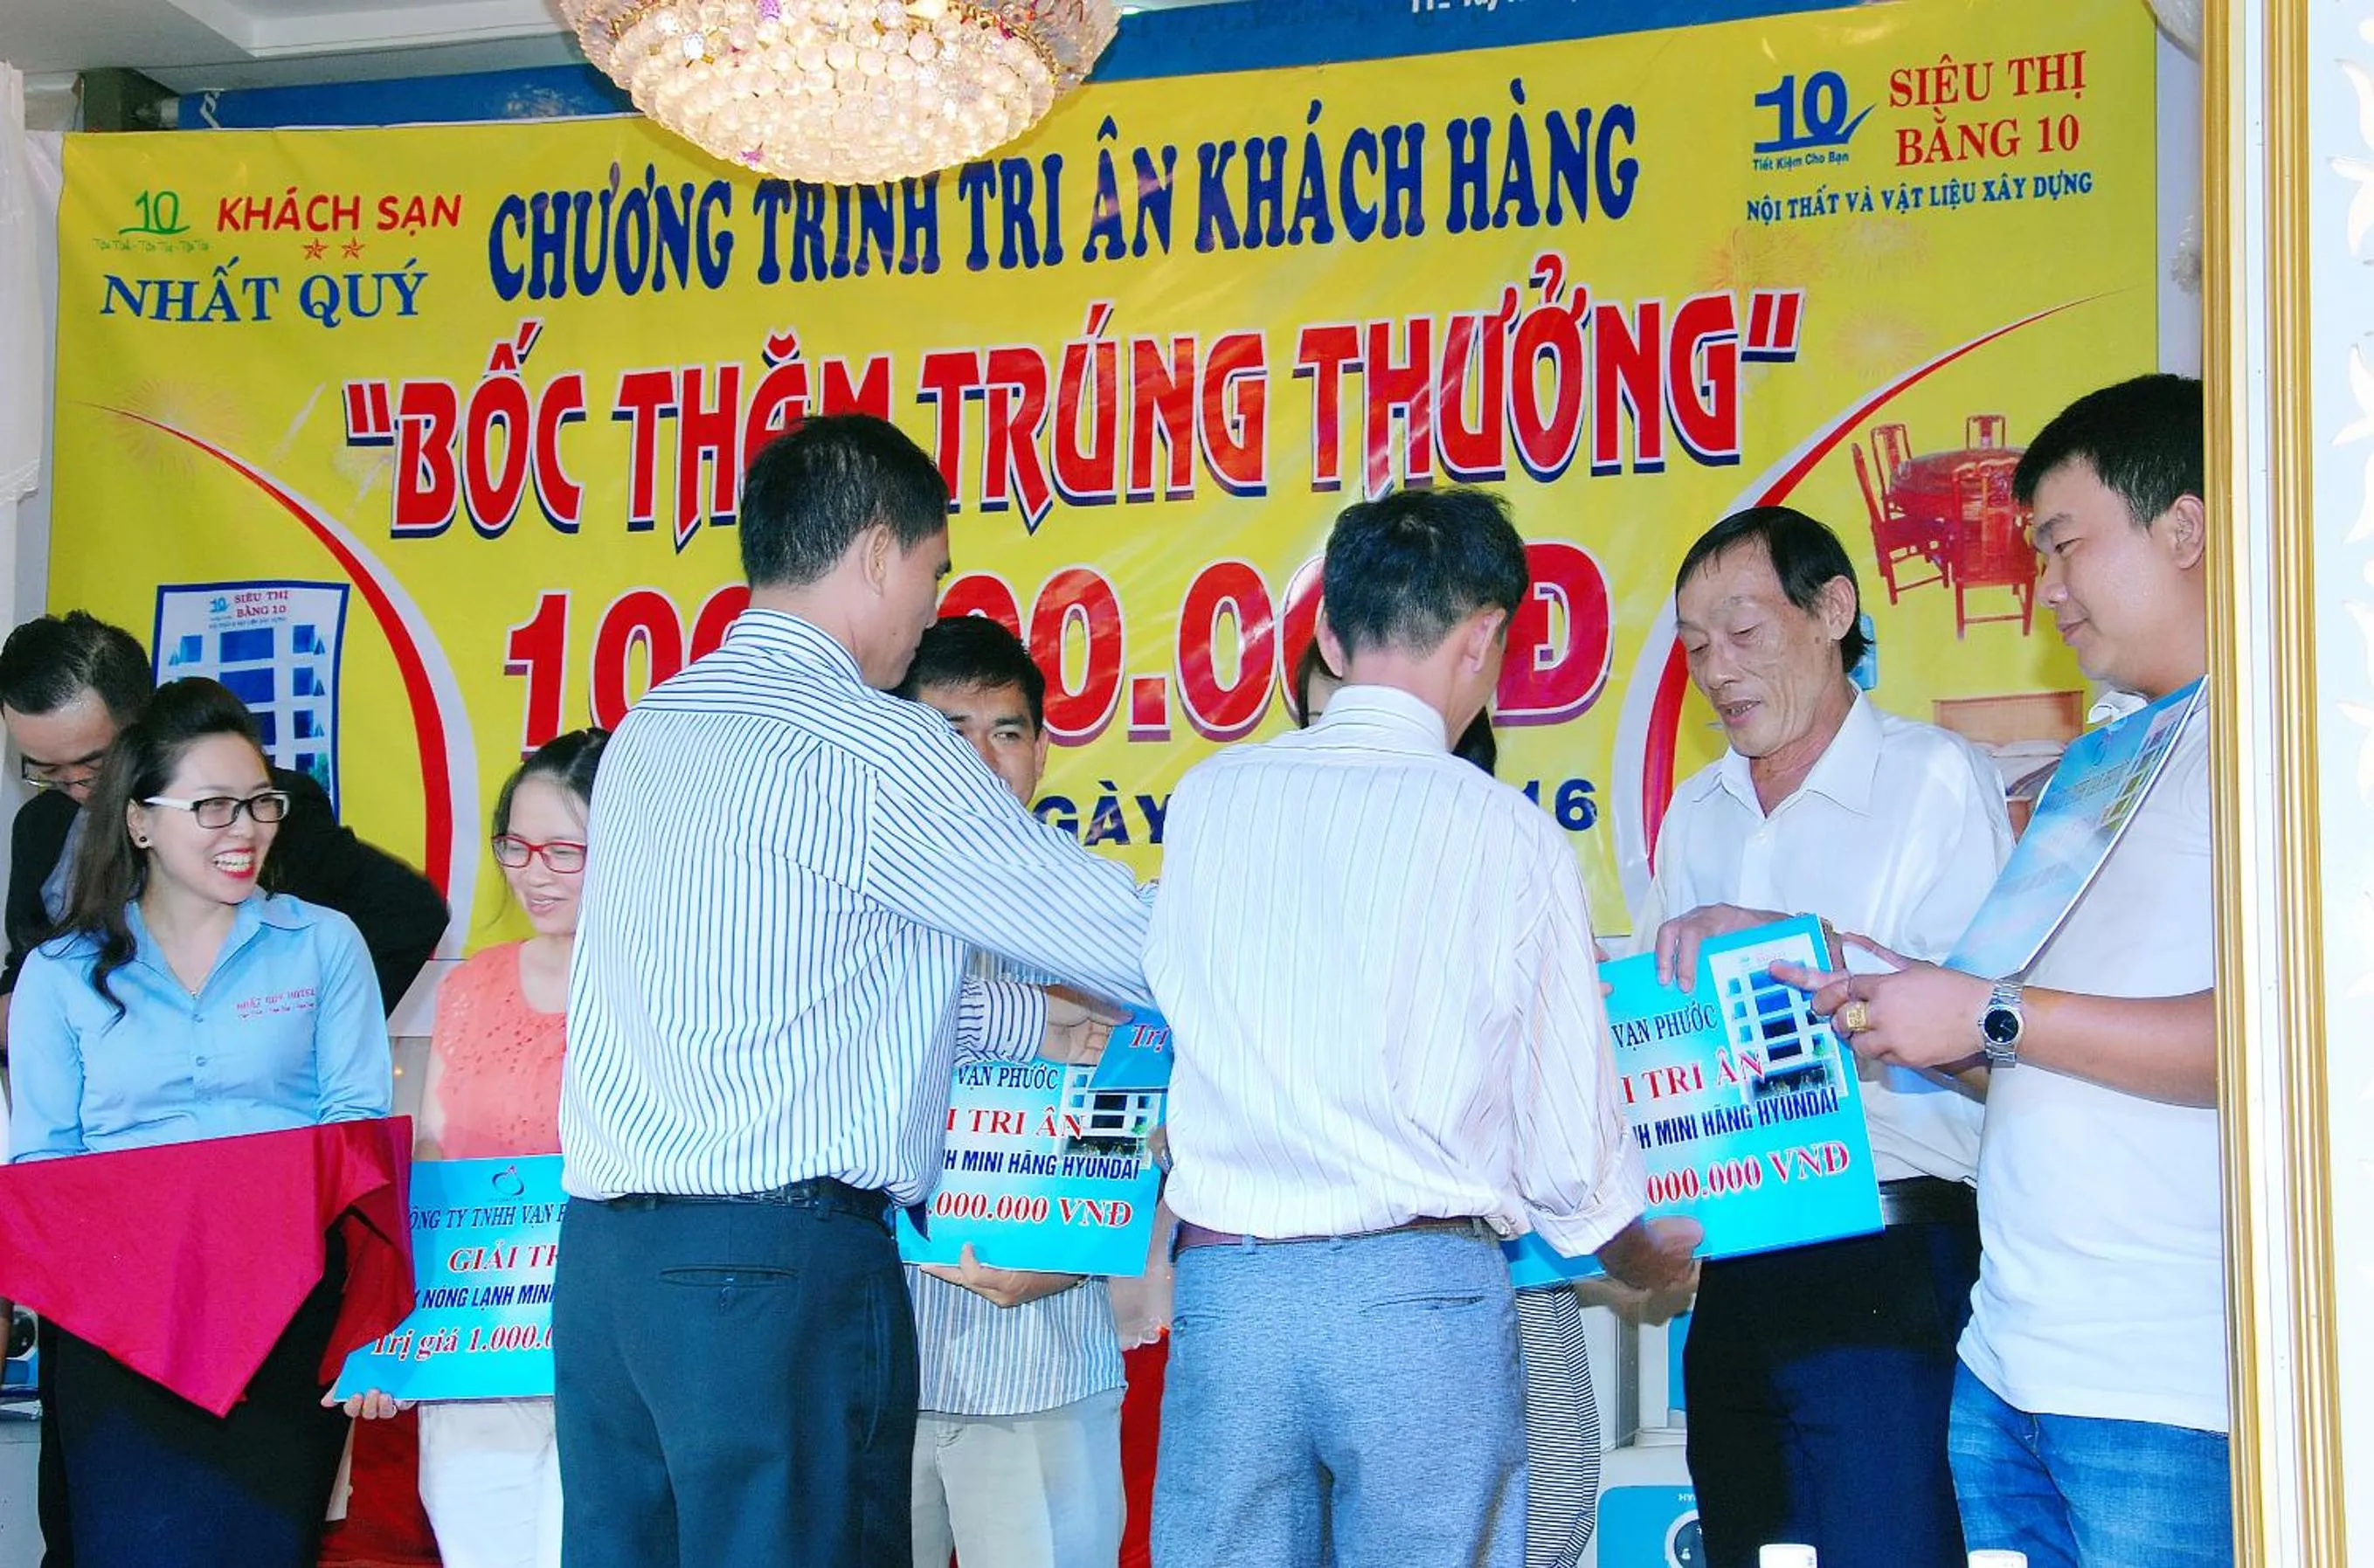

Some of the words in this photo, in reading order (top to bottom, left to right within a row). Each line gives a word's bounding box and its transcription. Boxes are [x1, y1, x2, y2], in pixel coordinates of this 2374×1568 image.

[1889, 53, 1993, 108] SIÊU
[2007, 50, 2087, 100] THỊ
[1754, 71, 1854, 153] 10
[1894, 106, 2021, 167] BẰNG
[2038, 114, 2079, 153] 10
[1805, 152, 1826, 166] Cho
[1828, 150, 1850, 166] Bạn
[135, 190, 180, 233] 10
[217, 186, 360, 233] KHÁCH
[377, 194, 461, 236] SẠN
[488, 162, 735, 301] CHƯƠNG
[959, 152, 1063, 271] TRI
[1081, 114, 1177, 264] ÂN
[1194, 99, 1426, 252] KHÁCH
[1445, 77, 1639, 234] HÀNG
[1747, 194, 1781, 225] NỘI
[1787, 184, 1840, 218] THẤT
[1845, 185, 1874, 213] VÀ
[1881, 183, 1923, 214] VẬT
[1930, 178, 1976, 211] LIỆU
[1983, 172, 2025, 203] XÂY
[2033, 169, 2094, 201] DỰNG
[100, 256, 280, 323] NHẤT
[299, 258, 428, 328] QUÝ
[916, 300, 1269, 535] TRÚNG
[1032, 779, 1172, 846] GÀY
[1130, 1023, 1170, 1052] Trị
[1610, 1018, 1651, 1051] VẠN
[1654, 1000, 1719, 1040] PHƯỚC
[997, 1062, 1059, 1090] PHƯỚC
[1641, 1060, 1705, 1100] TRI
[1716, 1046, 1766, 1086] ÂN
[967, 1109, 1027, 1136] TRI
[1035, 1105, 1086, 1139] ÂN
[1655, 1113, 1699, 1147] MINI
[1756, 1086, 1840, 1127] HYUNDAI
[961, 1150, 1003, 1173] MINI
[1061, 1155, 1140, 1180] HYUNDAI
[410, 1205, 440, 1230] ÔNG
[446, 1209, 469, 1228] TY
[472, 1205, 518, 1227] TNHH
[523, 1204, 555, 1229] VẠN
[926, 1190, 1049, 1223] .000.000
[448, 1240, 519, 1271] GIẢI
[472, 1285, 515, 1310] LẠNH
[416, 1327, 459, 1361] giá
